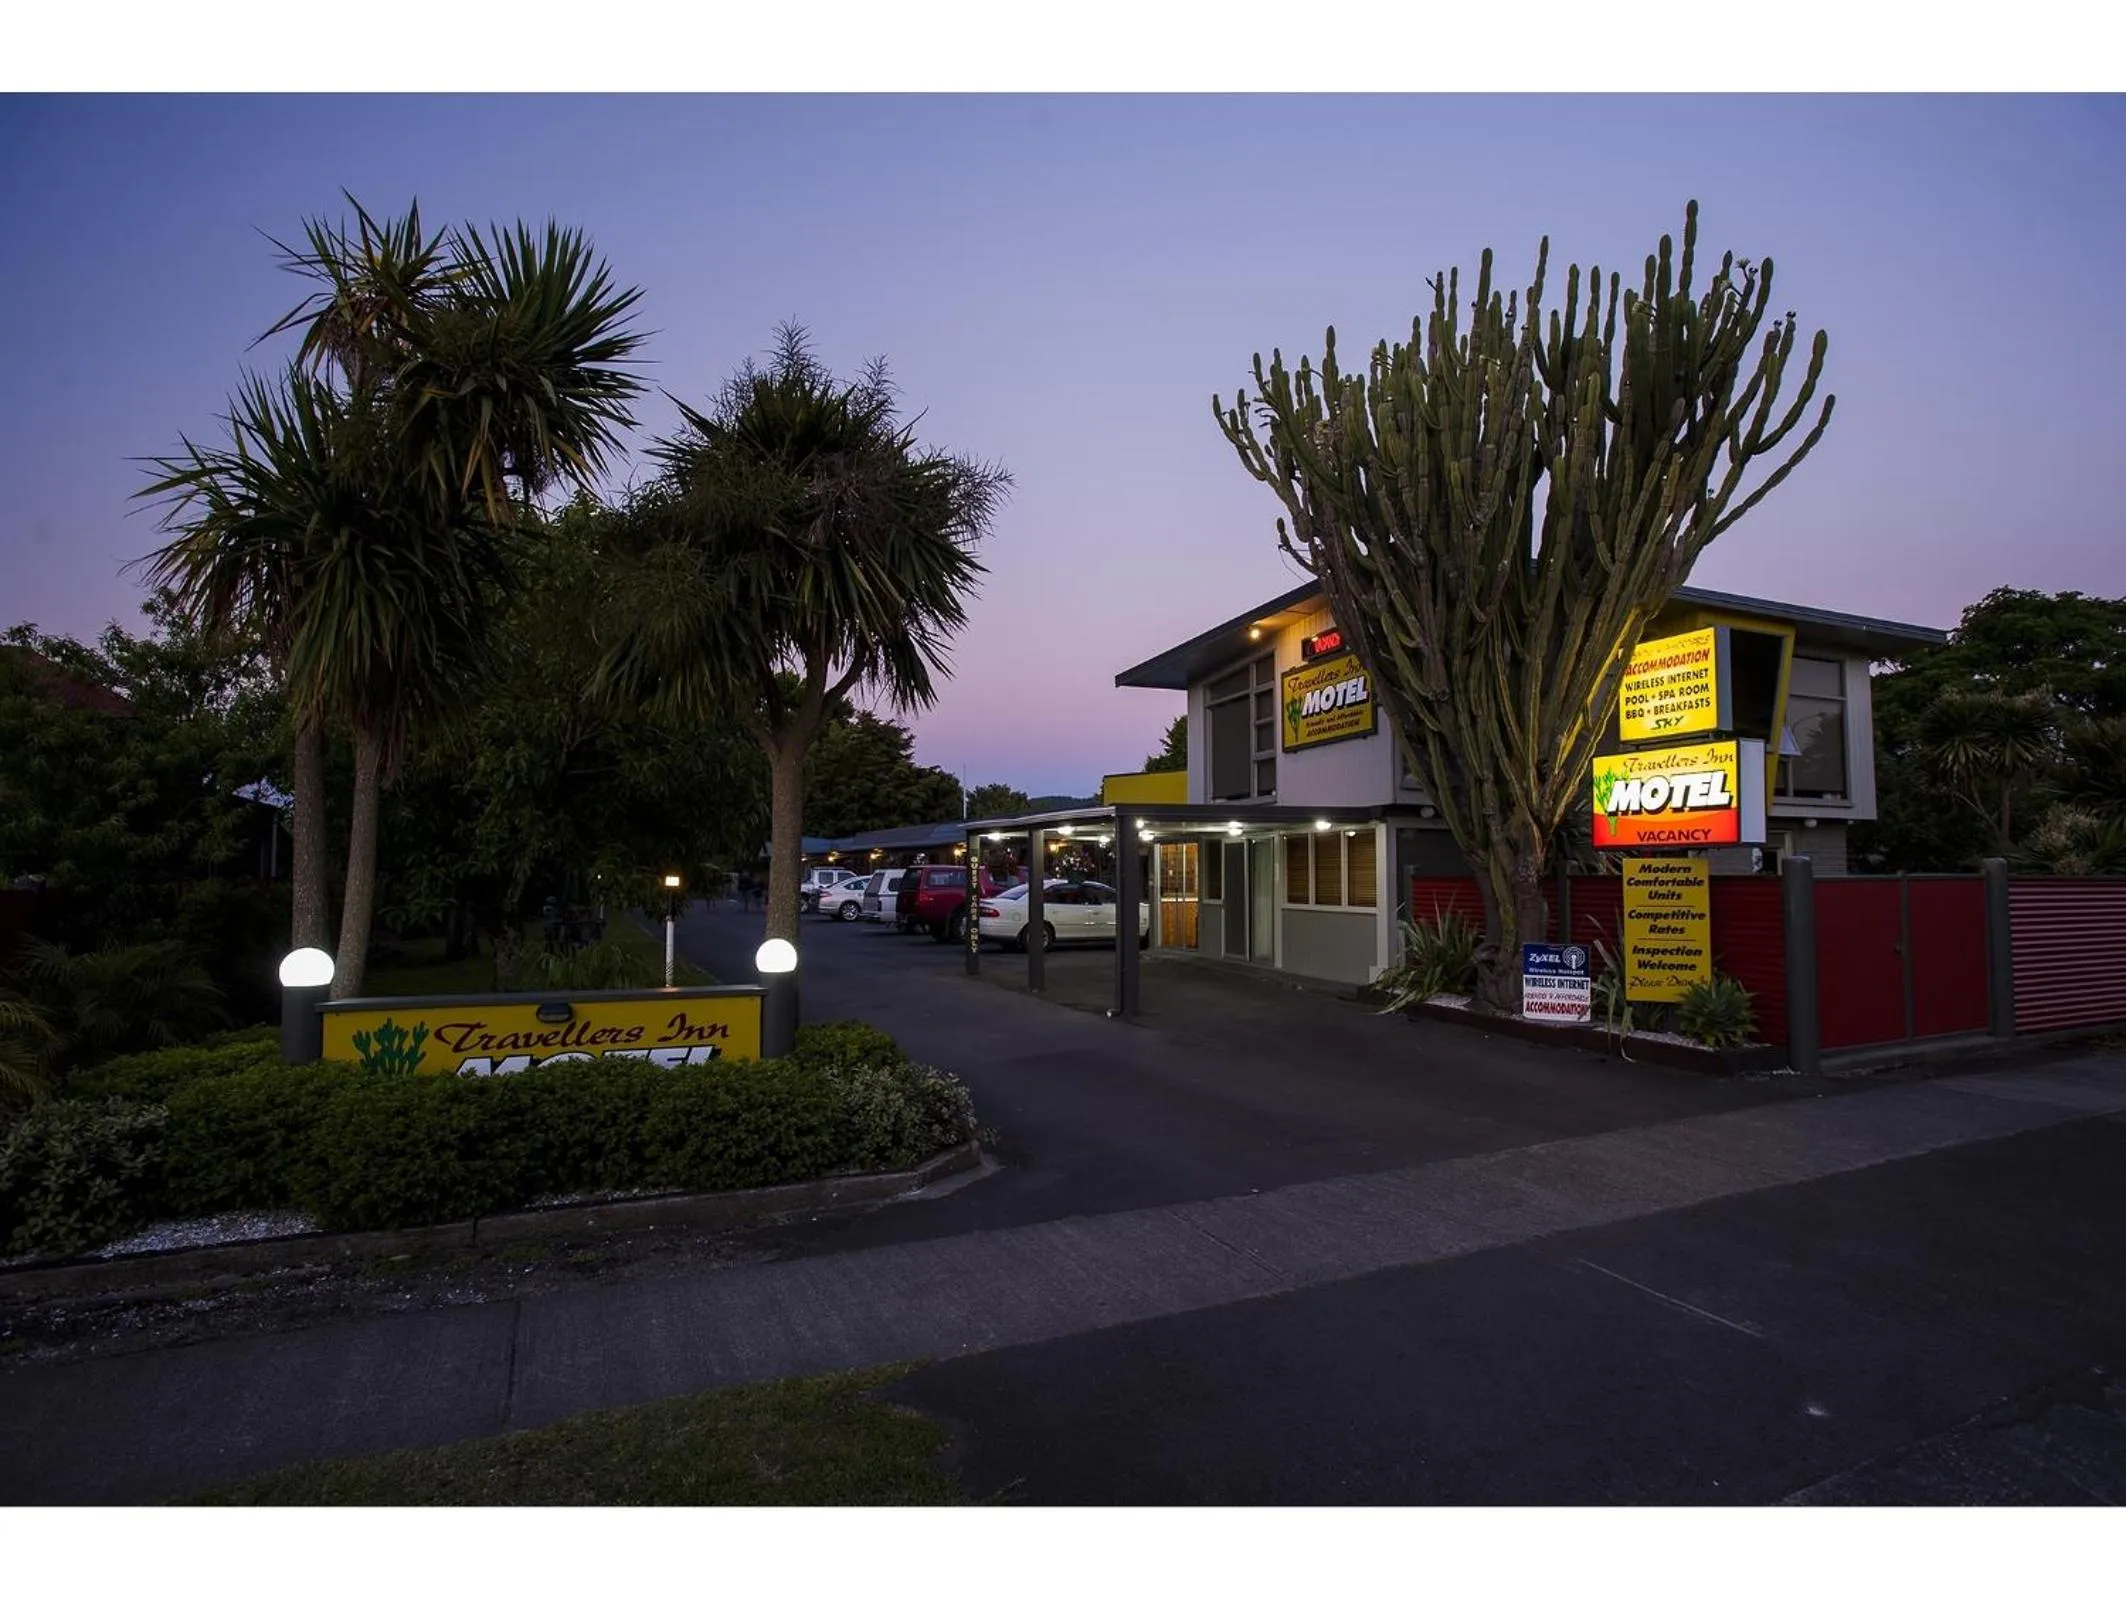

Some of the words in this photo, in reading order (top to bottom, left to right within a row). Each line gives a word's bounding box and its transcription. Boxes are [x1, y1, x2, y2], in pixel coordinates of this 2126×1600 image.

[1624, 648, 1711, 677] ACCOMMODATION
[1288, 668, 1341, 693] Travellers
[1625, 675, 1665, 692] WIRELESS
[1667, 668, 1709, 685] INTERNET
[1301, 676, 1369, 718] MOTEL
[1625, 694, 1650, 706] POOL
[1658, 690, 1676, 701] SPA
[1679, 684, 1710, 697] ROOM
[1625, 707, 1645, 720] BBQ
[1654, 697, 1711, 715] BREAKFASTS
[1650, 715, 1684, 730] SKY
[1623, 753, 1699, 773] Travellers
[1703, 747, 1735, 764] Inn
[1606, 771, 1732, 815] MOTEL
[1636, 828, 1712, 842] VACANCY
[1638, 863, 1692, 875] Modern
[1626, 876, 1704, 888] Comfortable
[1648, 889, 1683, 901] Units
[1628, 909, 1706, 921] Competitive
[1648, 924, 1686, 935] Rates
[1631, 945, 1703, 958] Inspection
[1637, 959, 1697, 972] Welcome
[1525, 977, 1556, 988] WIRELESS
[1557, 979, 1588, 990] INTERNET
[434, 1018, 645, 1054] Travellers
[658, 1012, 731, 1043] Inn
